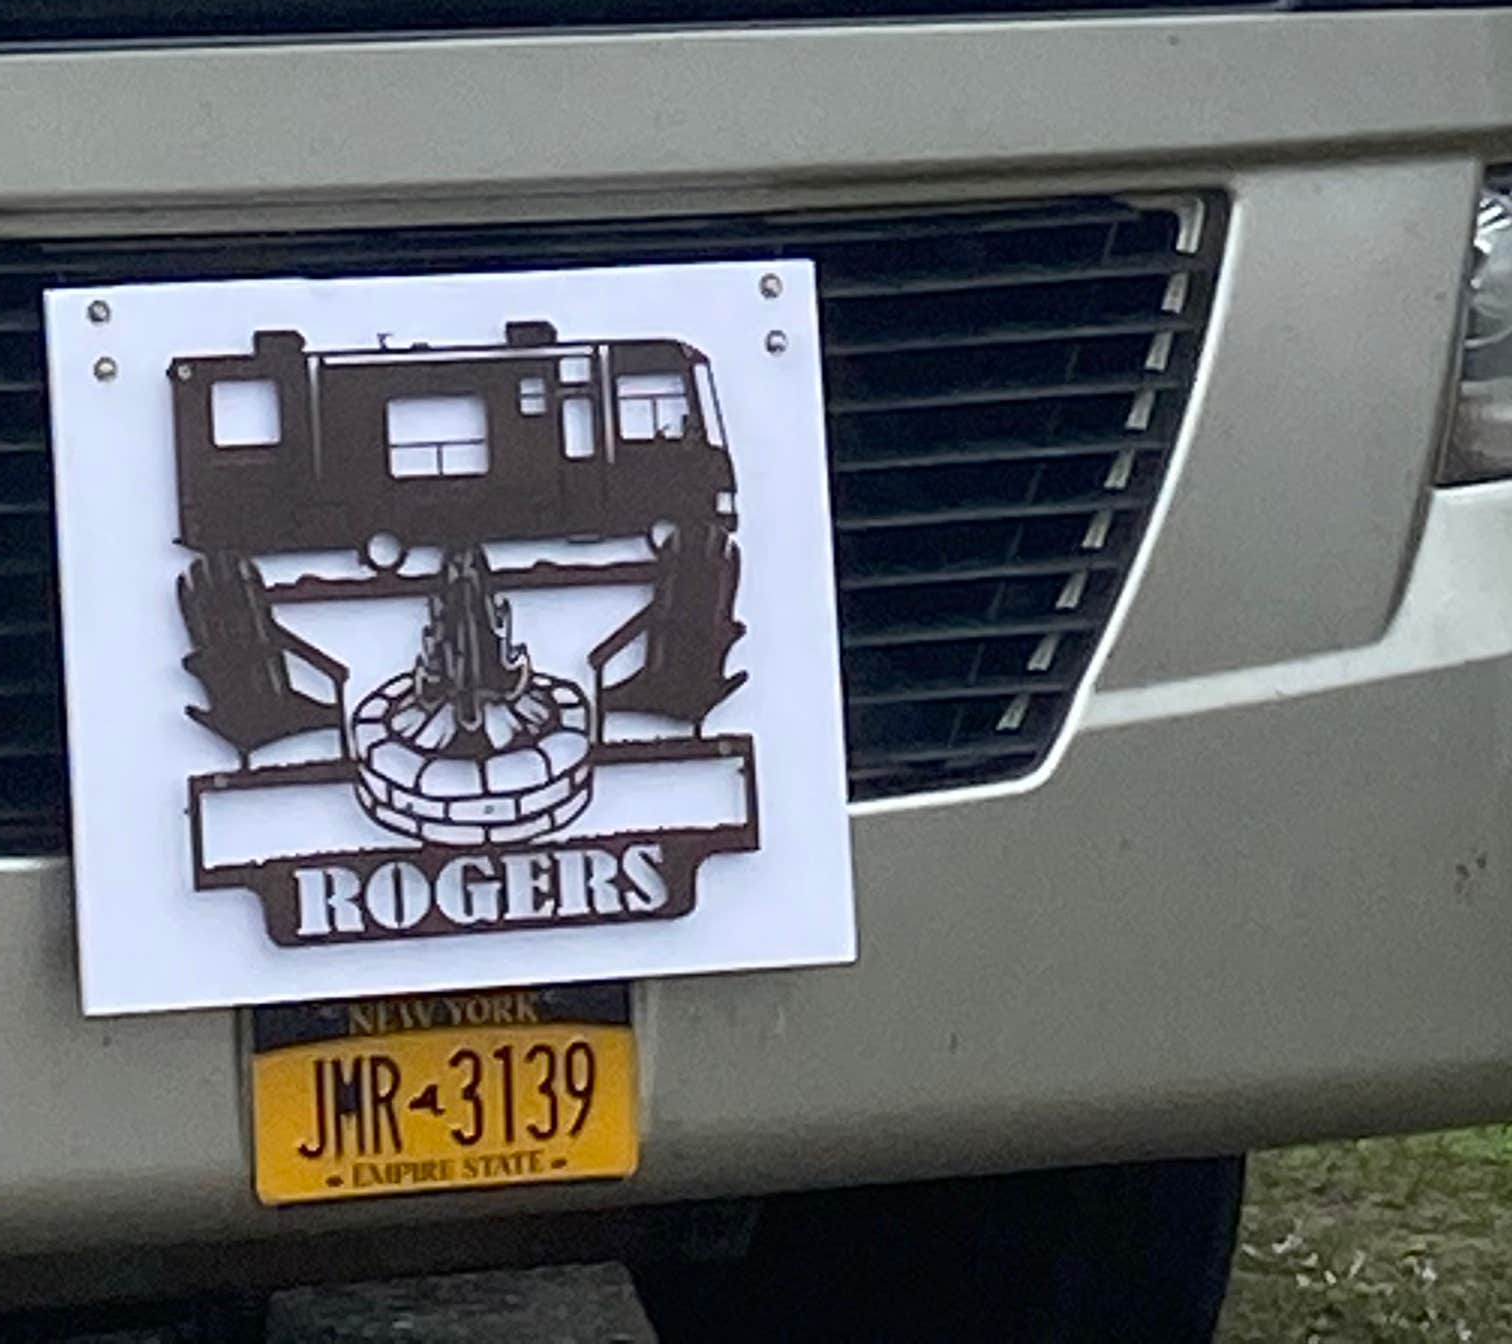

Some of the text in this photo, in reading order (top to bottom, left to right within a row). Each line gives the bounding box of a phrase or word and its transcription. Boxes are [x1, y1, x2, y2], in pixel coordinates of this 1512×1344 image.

[296, 845, 668, 937] ROGERS
[350, 993, 539, 1035] NEW YORK
[297, 1041, 596, 1158] JMR 3139
[352, 1149, 544, 1186] EMPIRE STATE
